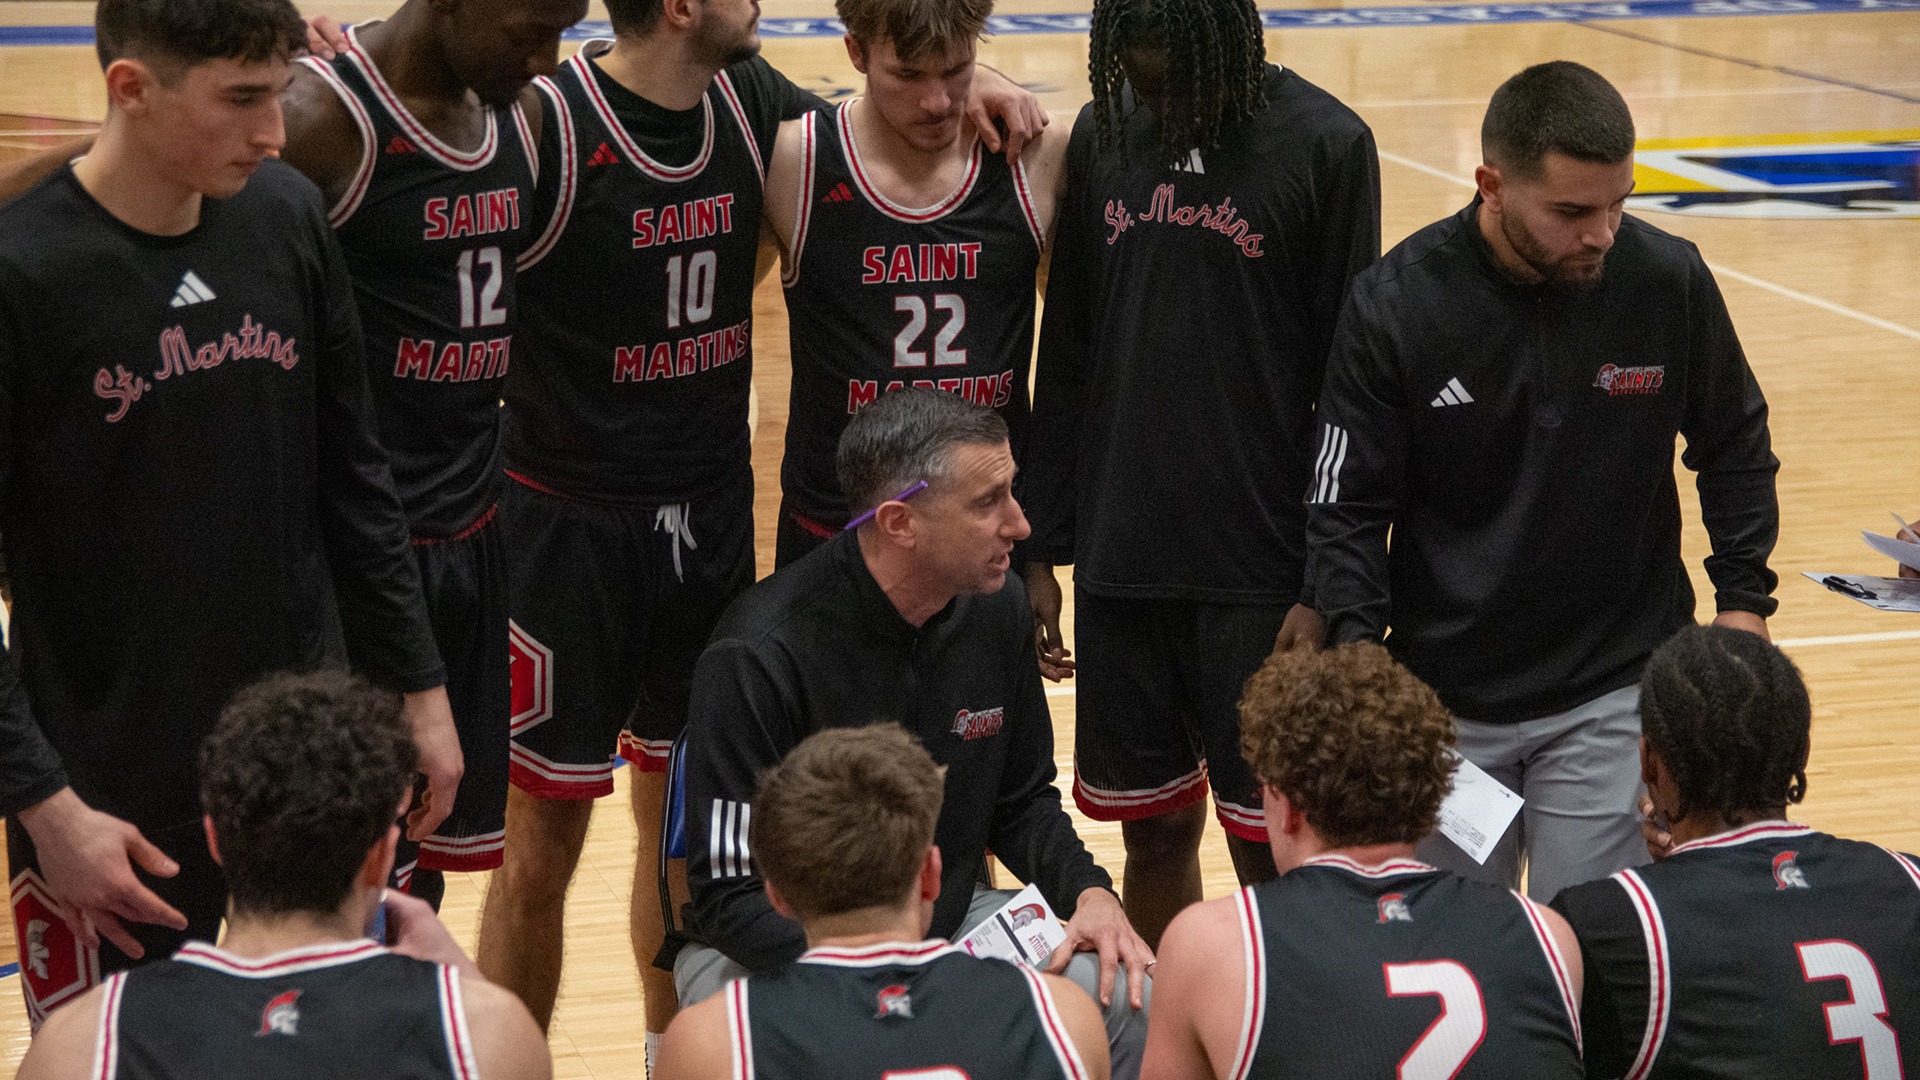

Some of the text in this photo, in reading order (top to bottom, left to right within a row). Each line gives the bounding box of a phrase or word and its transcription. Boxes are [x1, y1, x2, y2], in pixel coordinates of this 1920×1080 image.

[423, 187, 520, 240] SAINT
[632, 193, 734, 249] SAINT
[1104, 183, 1264, 257] St. Martins
[456, 246, 507, 328] 12
[666, 250, 717, 328] 10
[862, 241, 982, 284] SAINT
[93, 313, 300, 423] St. Martins
[613, 318, 749, 383] MARTINS
[893, 294, 968, 368] 22
[1382, 959, 1488, 1080] 2
[1794, 938, 1905, 1080] 3
